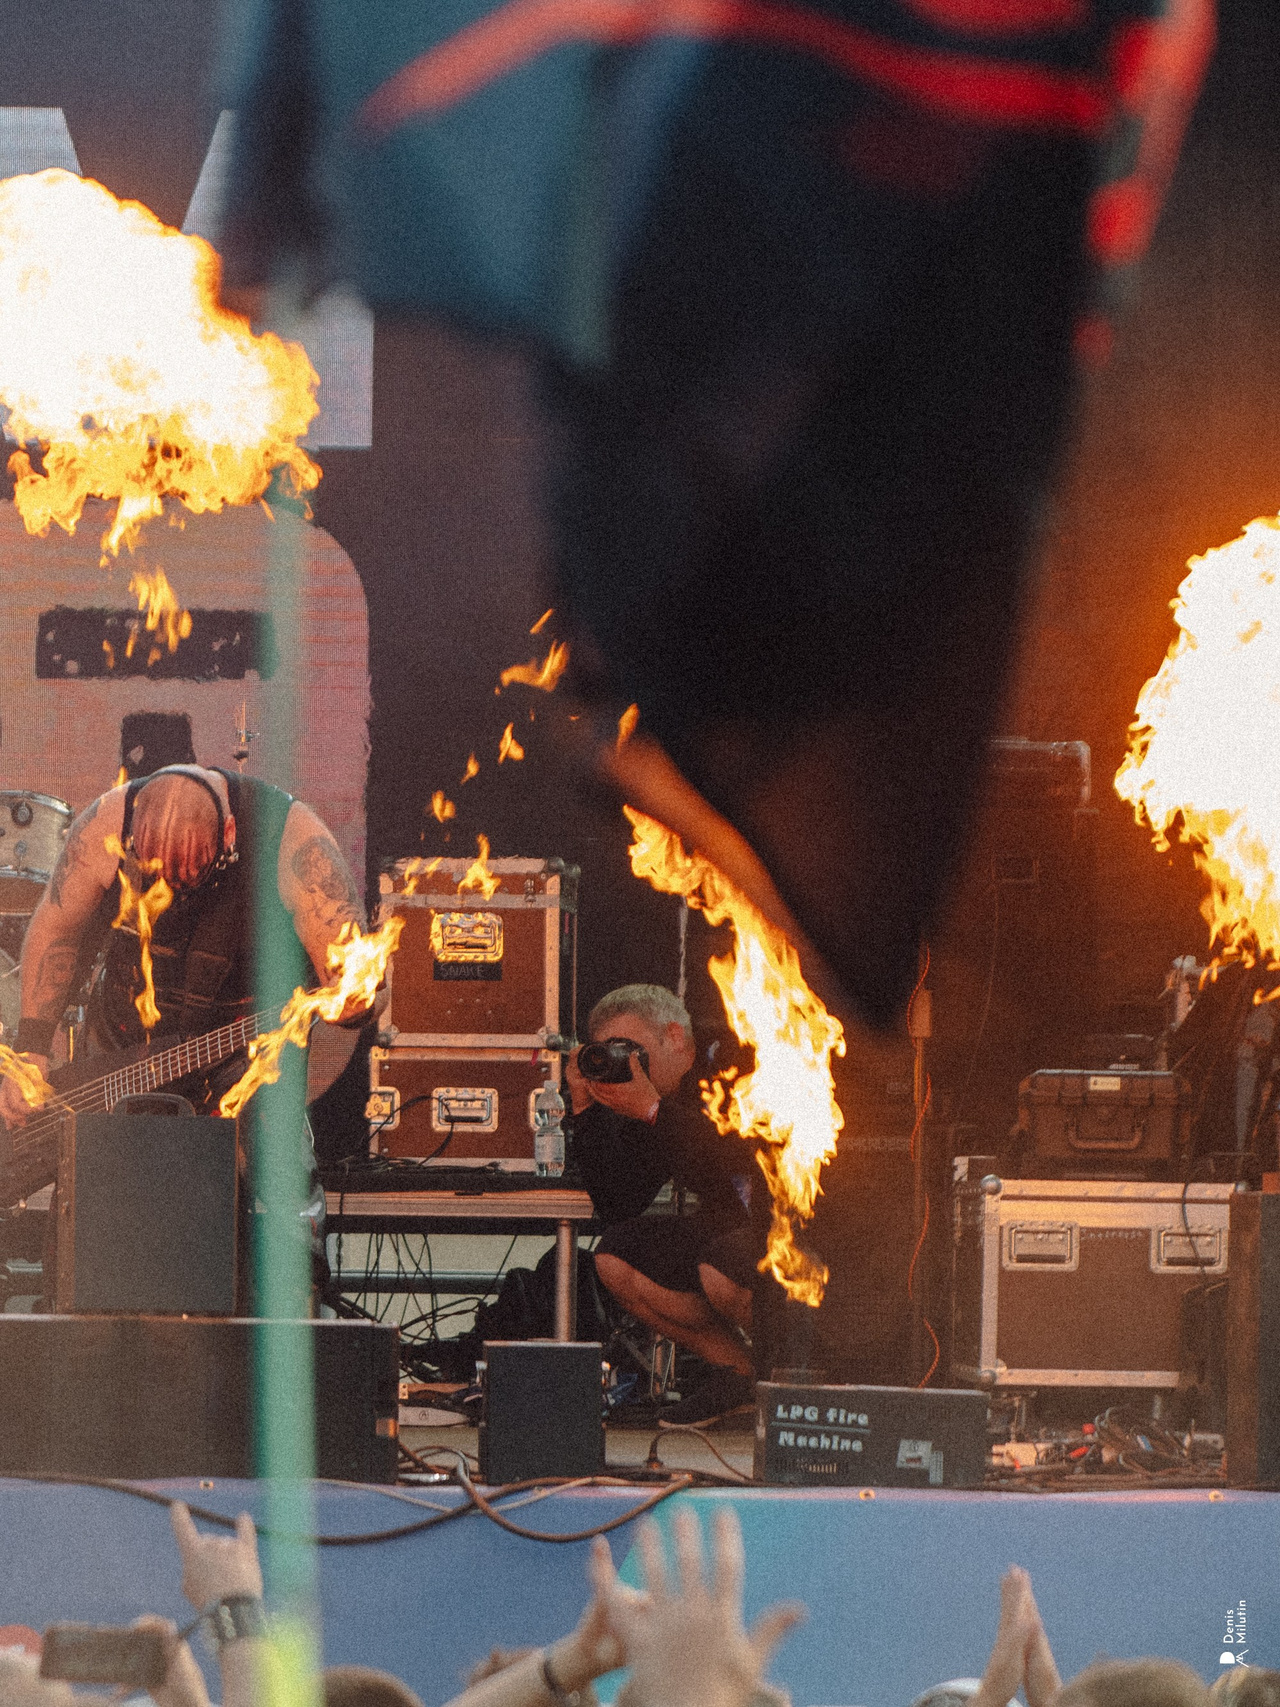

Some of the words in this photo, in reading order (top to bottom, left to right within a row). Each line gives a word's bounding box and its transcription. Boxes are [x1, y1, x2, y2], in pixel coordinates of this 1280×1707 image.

[775, 1404, 819, 1422] LPG
[825, 1406, 869, 1426] fire
[777, 1430, 863, 1452] Machine
